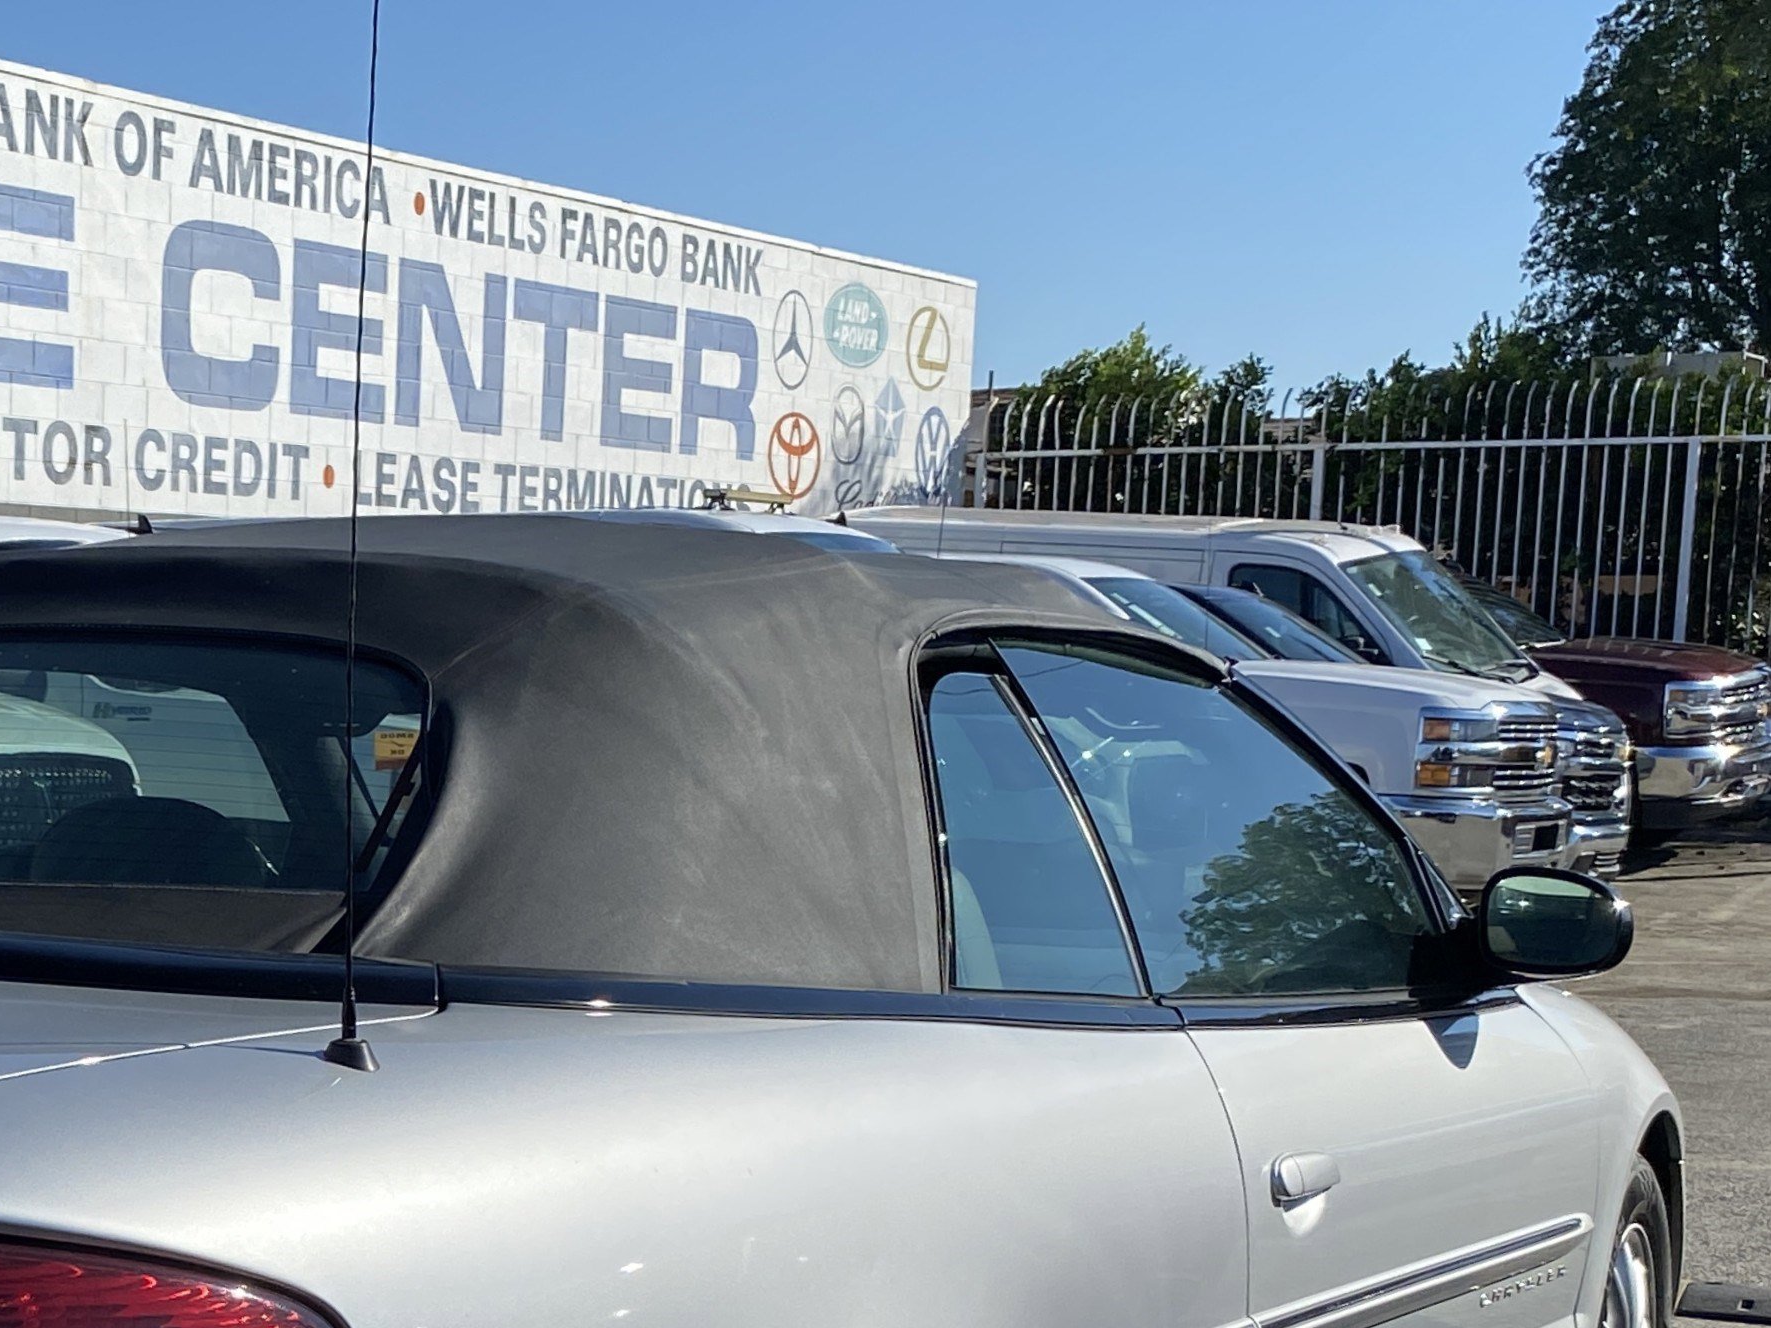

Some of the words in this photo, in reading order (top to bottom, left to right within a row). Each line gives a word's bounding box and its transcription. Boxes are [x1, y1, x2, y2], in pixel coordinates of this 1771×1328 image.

[113, 110, 175, 181] OF
[189, 127, 391, 225] AMERICA
[430, 178, 548, 256] WELLS
[560, 206, 668, 278] FARGO
[681, 233, 764, 297] BANK
[161, 218, 760, 462] CENTER
[837, 298, 870, 323] LAND
[839, 327, 879, 352] ROVER
[135, 428, 310, 502] CREDIT
[356, 450, 480, 513] LEASE
[493, 463, 751, 512] TERMINATIOS
